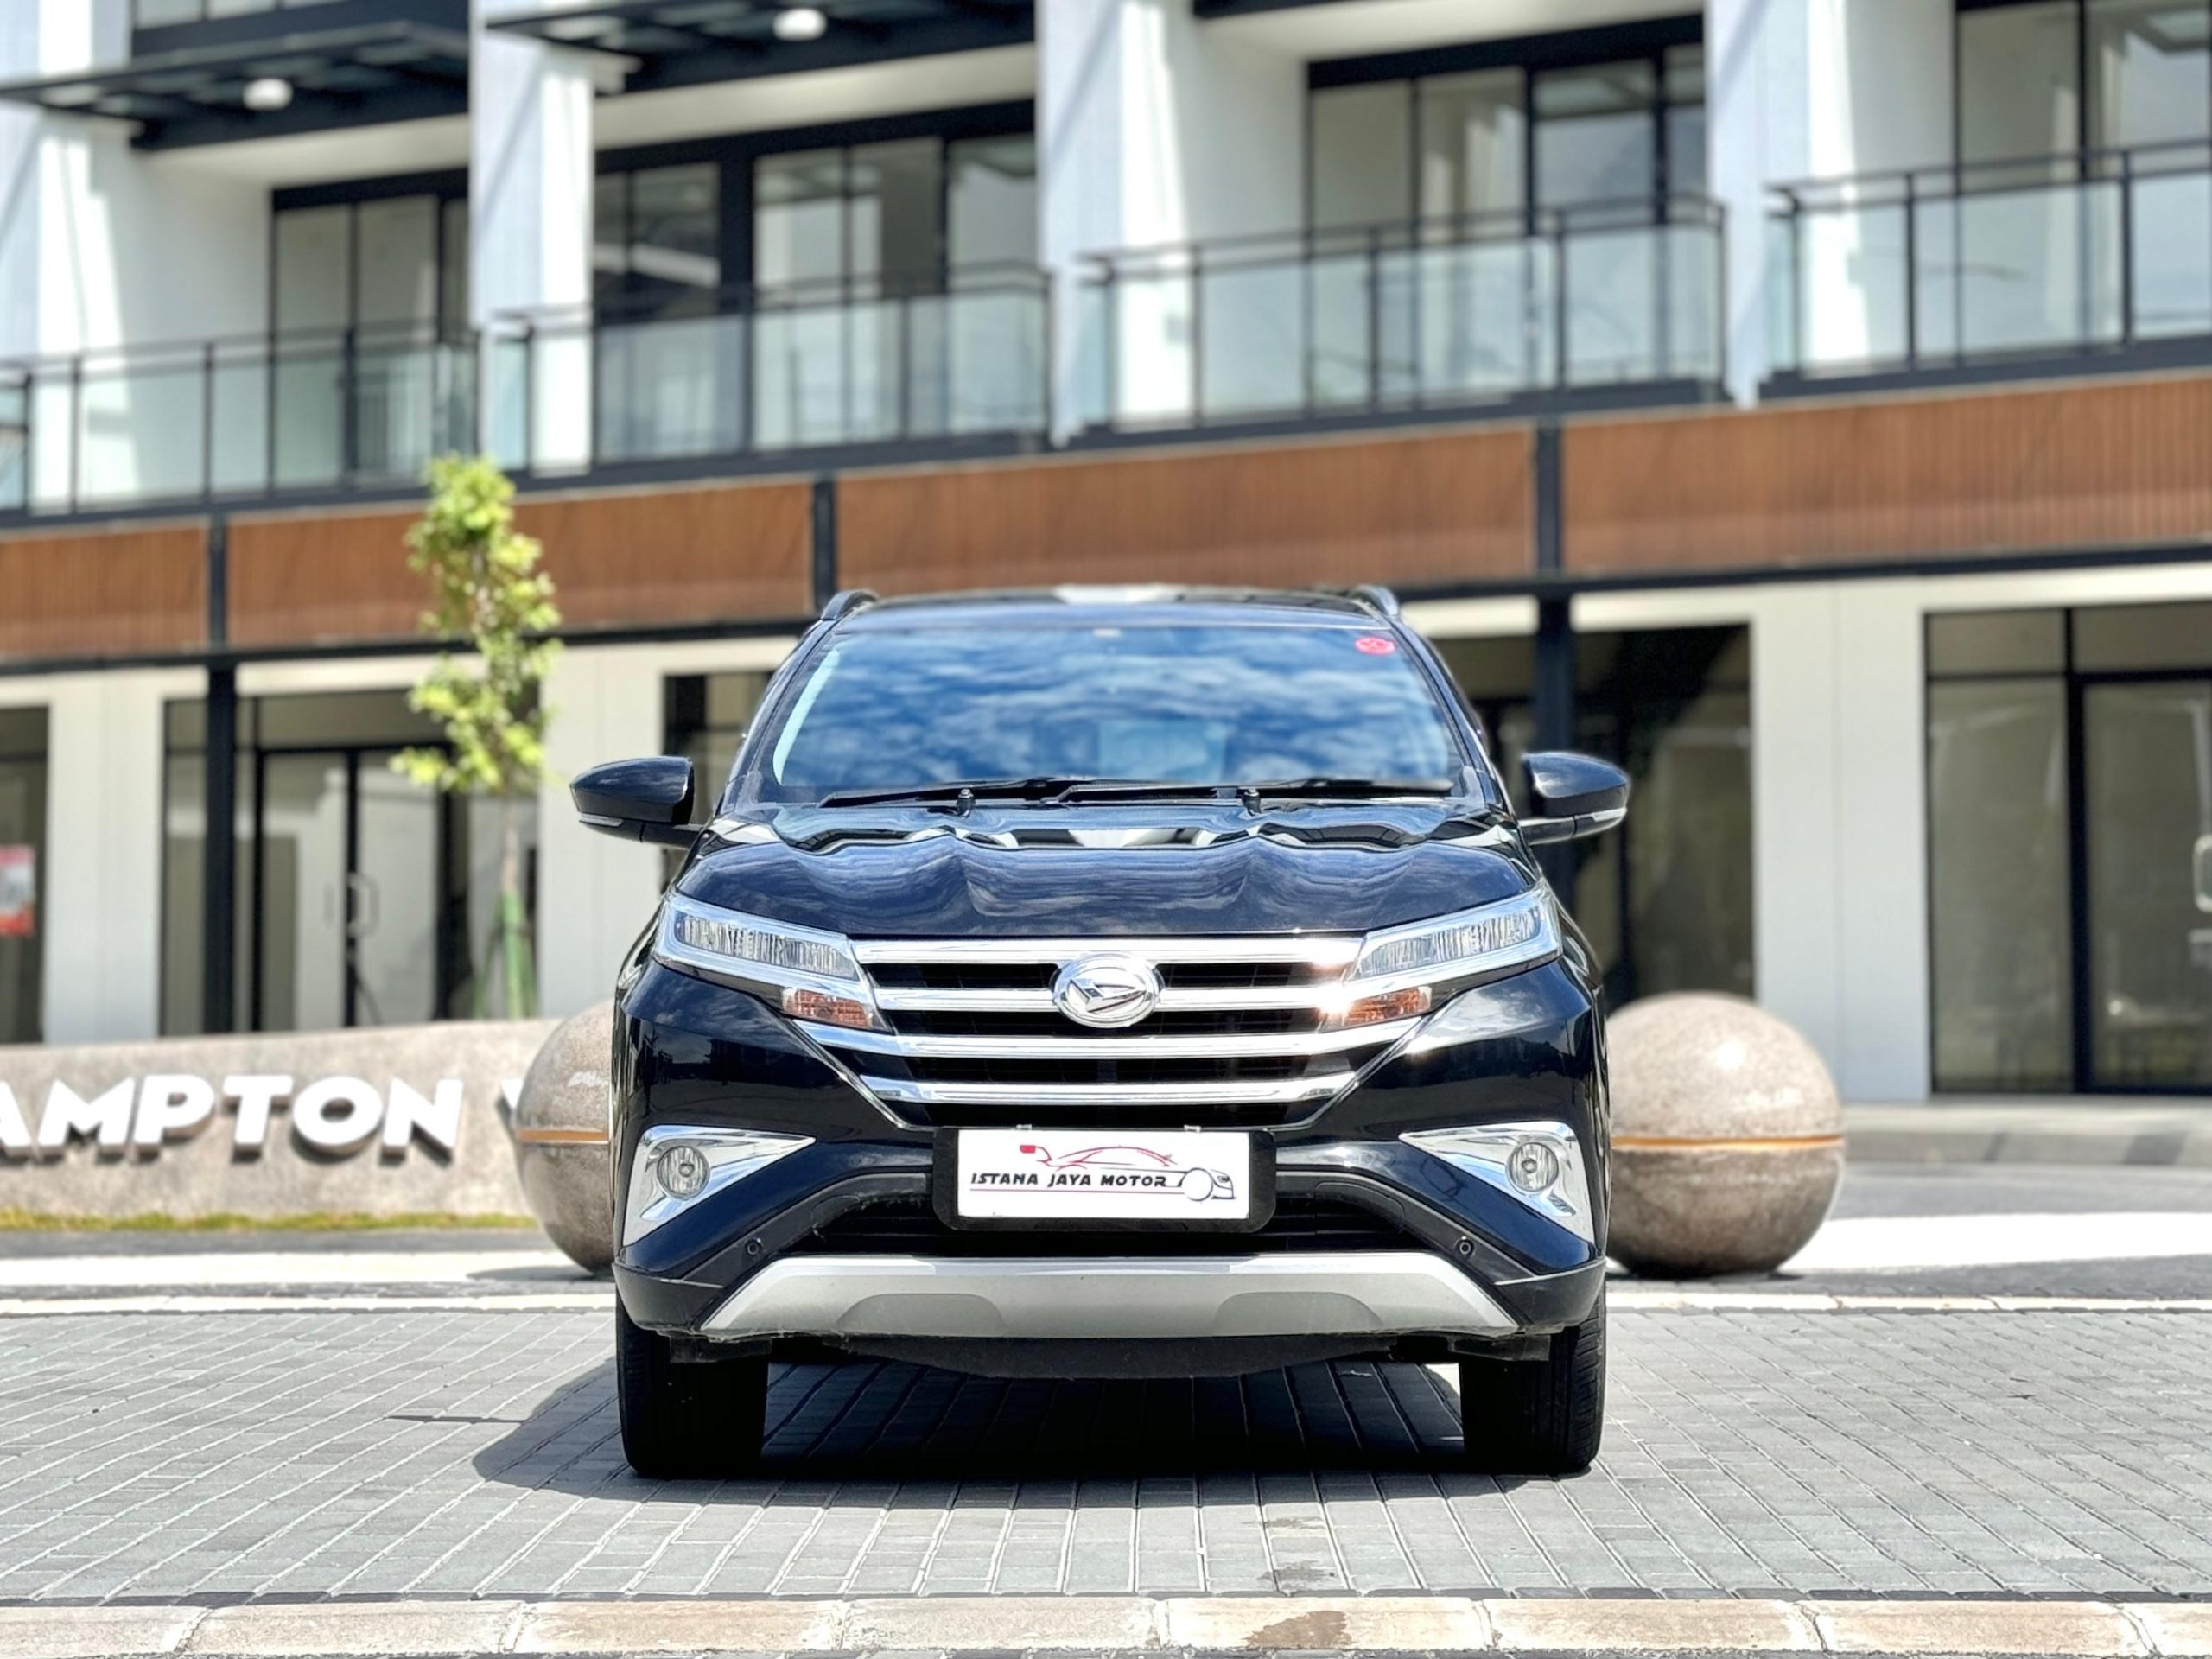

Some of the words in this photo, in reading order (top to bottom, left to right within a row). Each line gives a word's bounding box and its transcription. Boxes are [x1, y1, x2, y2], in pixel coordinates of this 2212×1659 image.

[970, 1173, 1039, 1185] ISTANA
[1047, 1173, 1091, 1188] JAYA
[1100, 1174, 1167, 1187] MOTOR
